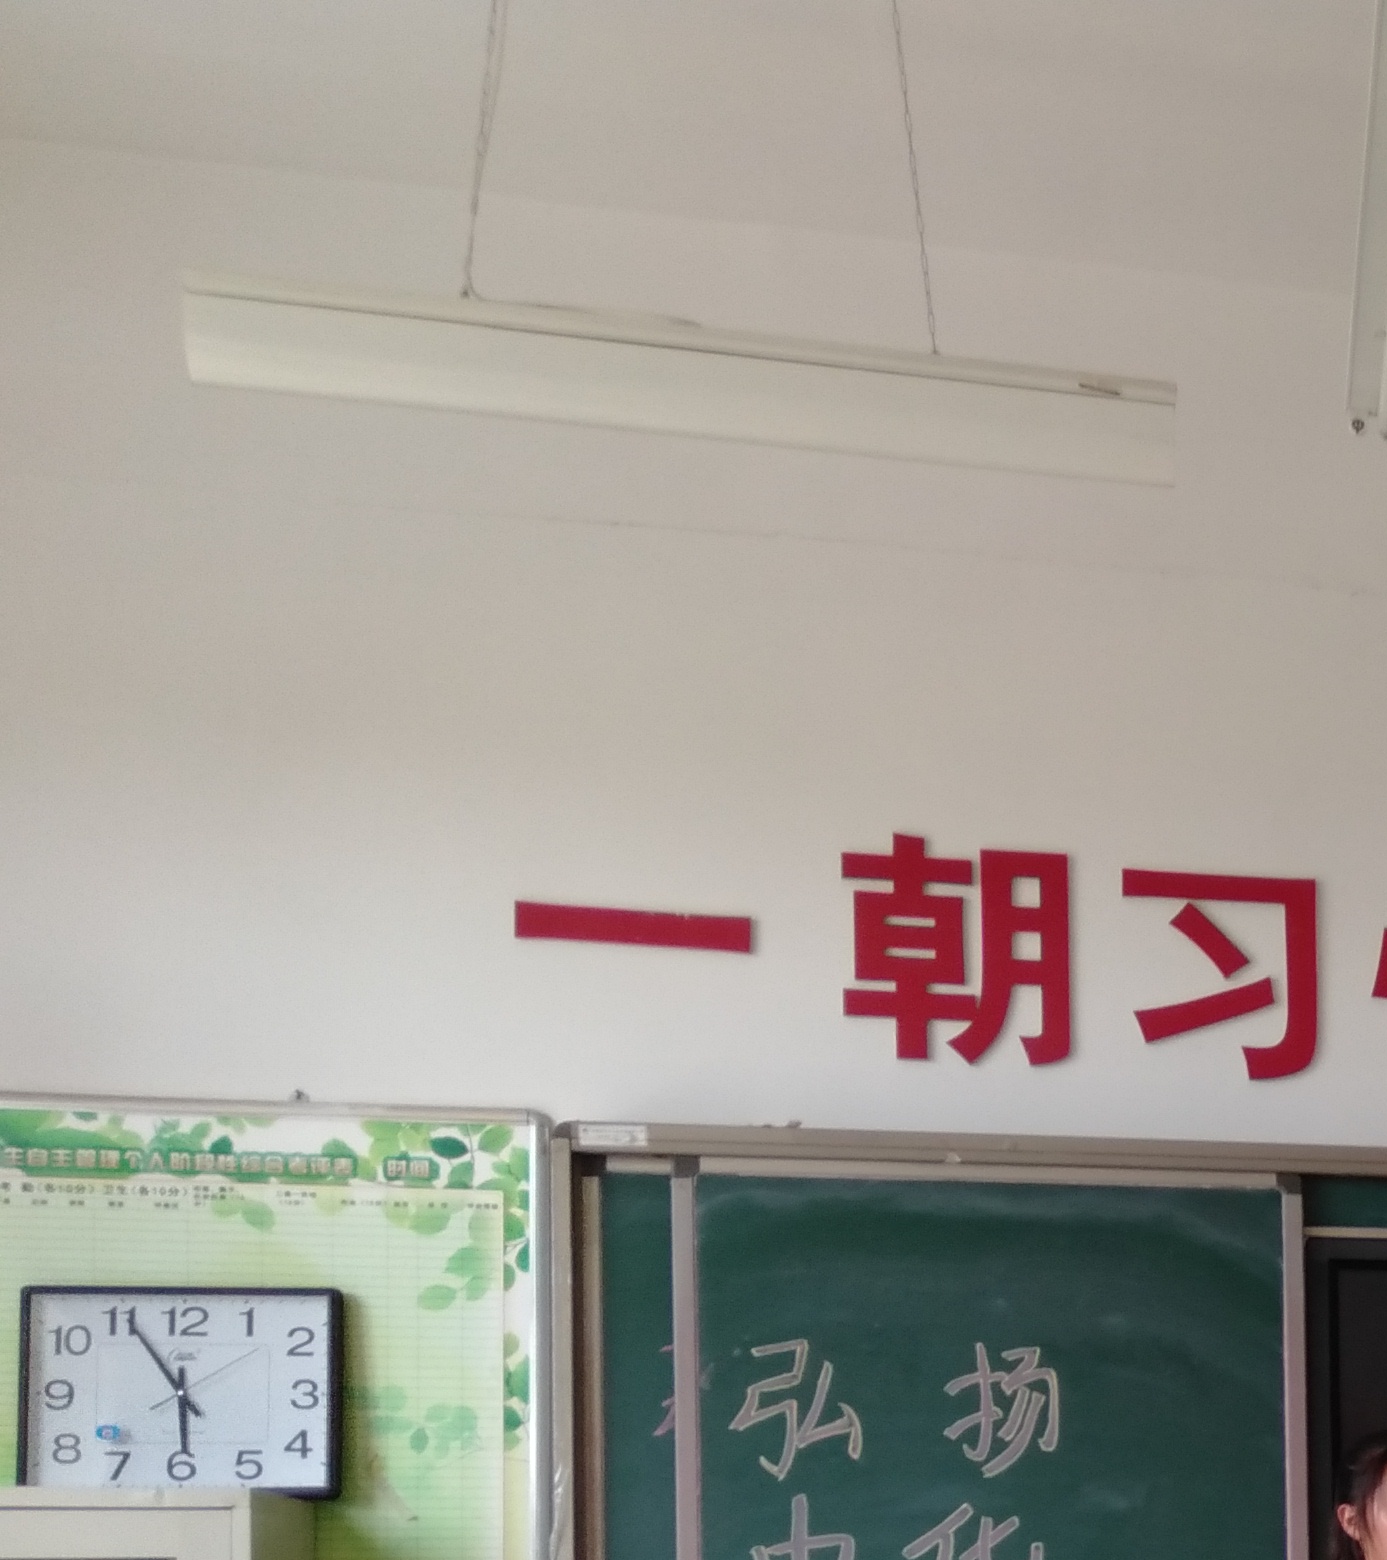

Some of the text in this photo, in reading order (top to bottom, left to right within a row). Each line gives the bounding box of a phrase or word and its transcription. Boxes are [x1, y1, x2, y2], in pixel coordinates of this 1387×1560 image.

[102, 1306, 137, 1337] 11
[160, 1306, 209, 1337] 12
[239, 1306, 255, 1337] 1
[50, 1324, 92, 1356] 10
[286, 1326, 315, 1357] 2
[44, 1379, 75, 1411] 9
[289, 1379, 319, 1410] 3
[52, 1432, 82, 1464] 8
[283, 1429, 314, 1459] 4
[104, 1451, 131, 1481] 7
[166, 1450, 197, 1482] 6
[234, 1450, 263, 1480] 5
